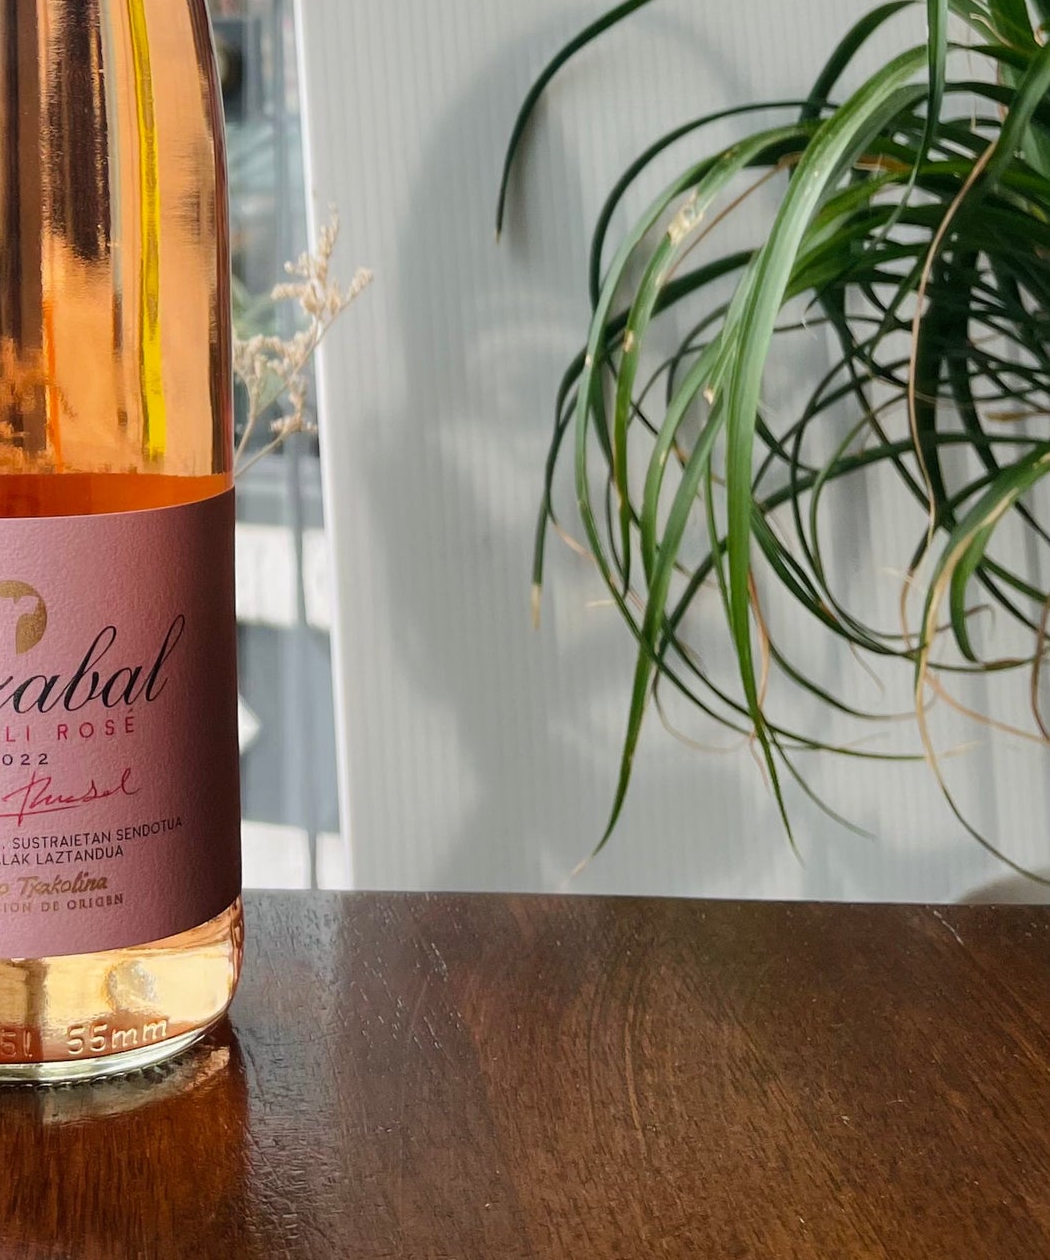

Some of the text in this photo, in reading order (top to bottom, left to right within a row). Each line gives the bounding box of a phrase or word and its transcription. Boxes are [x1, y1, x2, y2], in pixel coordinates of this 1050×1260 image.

[57, 708, 137, 741] ROSÉ
[13, 830, 111, 850] SUSTRAIETAN
[116, 817, 183, 841] SENDOTUA
[36, 845, 124, 865] LAZTANDUA
[16, 870, 109, 898] Txakolina
[40, 900, 60, 913] DE
[66, 893, 124, 910] ORIGEN
[65, 1015, 169, 1056] 55mm
